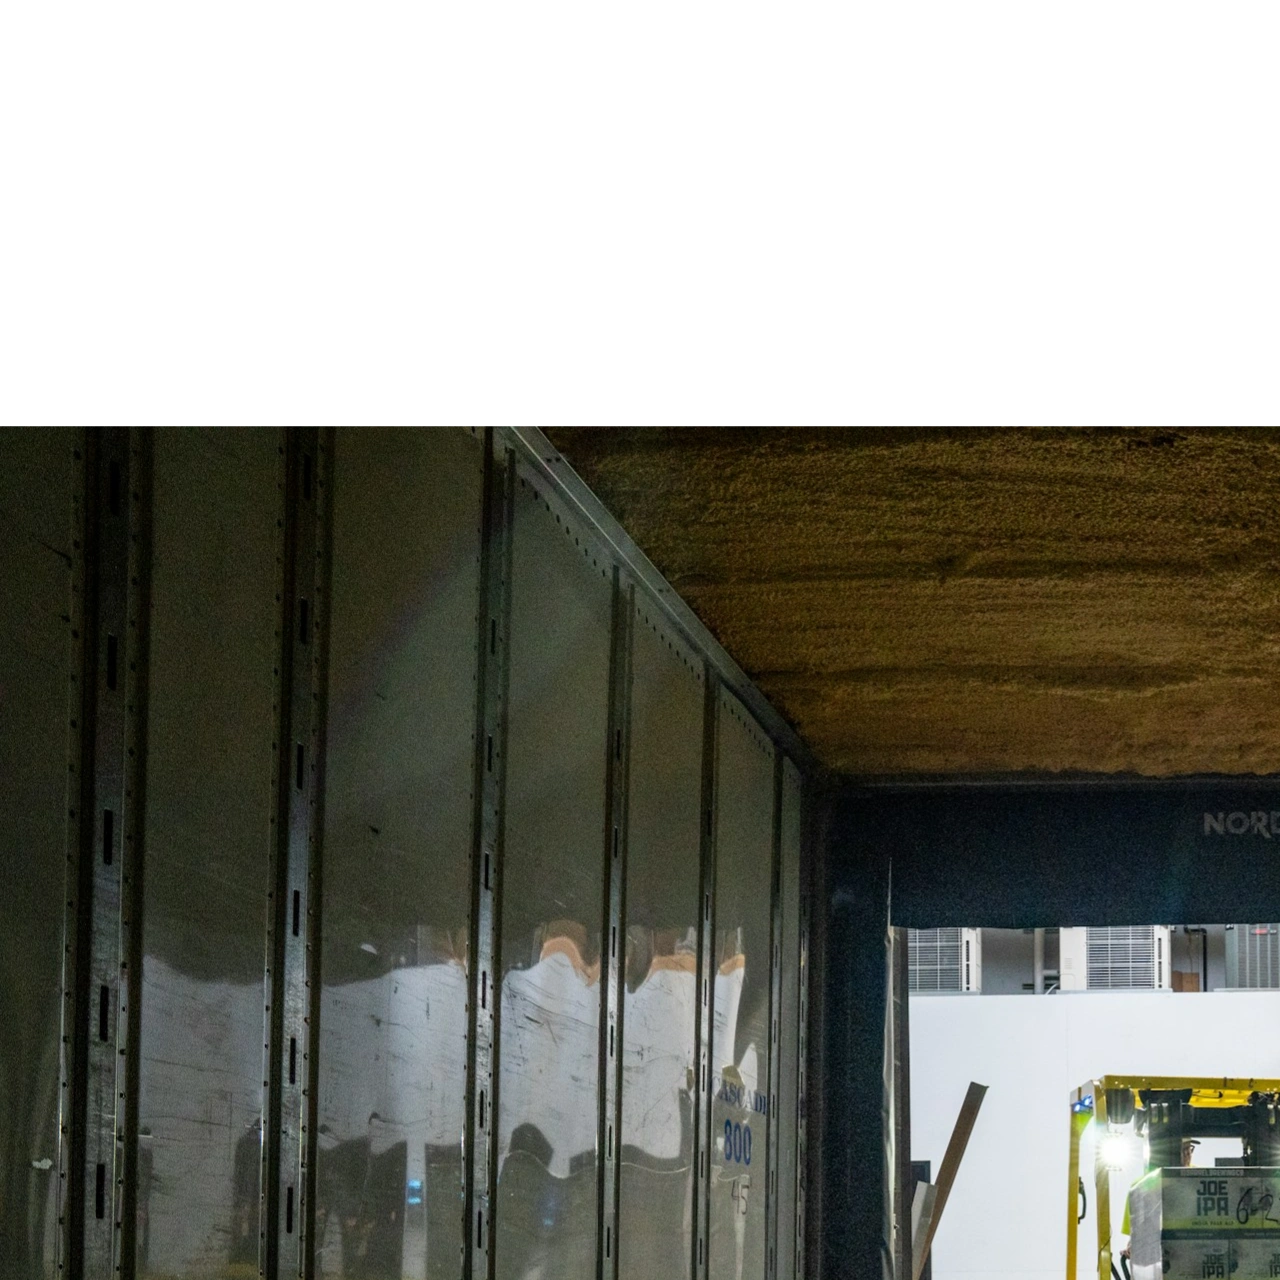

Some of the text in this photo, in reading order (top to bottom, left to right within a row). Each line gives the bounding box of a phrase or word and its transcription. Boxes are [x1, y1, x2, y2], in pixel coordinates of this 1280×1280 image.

[724, 1118, 752, 1166] 800
[1197, 1180, 1228, 1196] JOE
[1197, 1197, 1229, 1216] IPA
[1203, 1254, 1224, 1265] JOE
[1202, 1265, 1224, 1279] IPA
